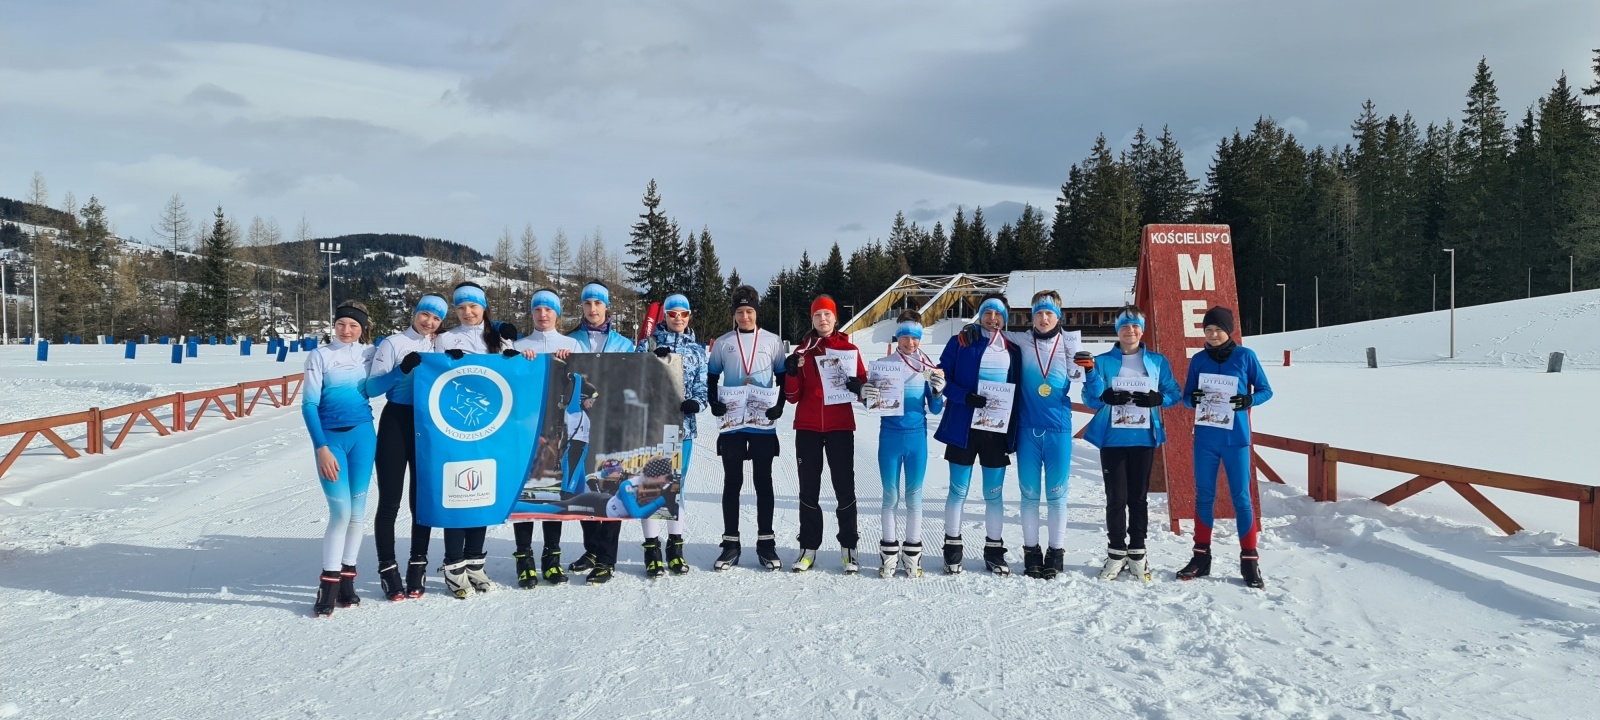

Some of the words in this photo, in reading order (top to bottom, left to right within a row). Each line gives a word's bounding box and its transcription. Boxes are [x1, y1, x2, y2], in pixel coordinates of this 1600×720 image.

[1204, 378, 1234, 386] DYPLOM
[751, 389, 777, 397] DYPLOM
[982, 385, 1011, 393] DYPLOM
[445, 424, 496, 440] WODZISŁAW
